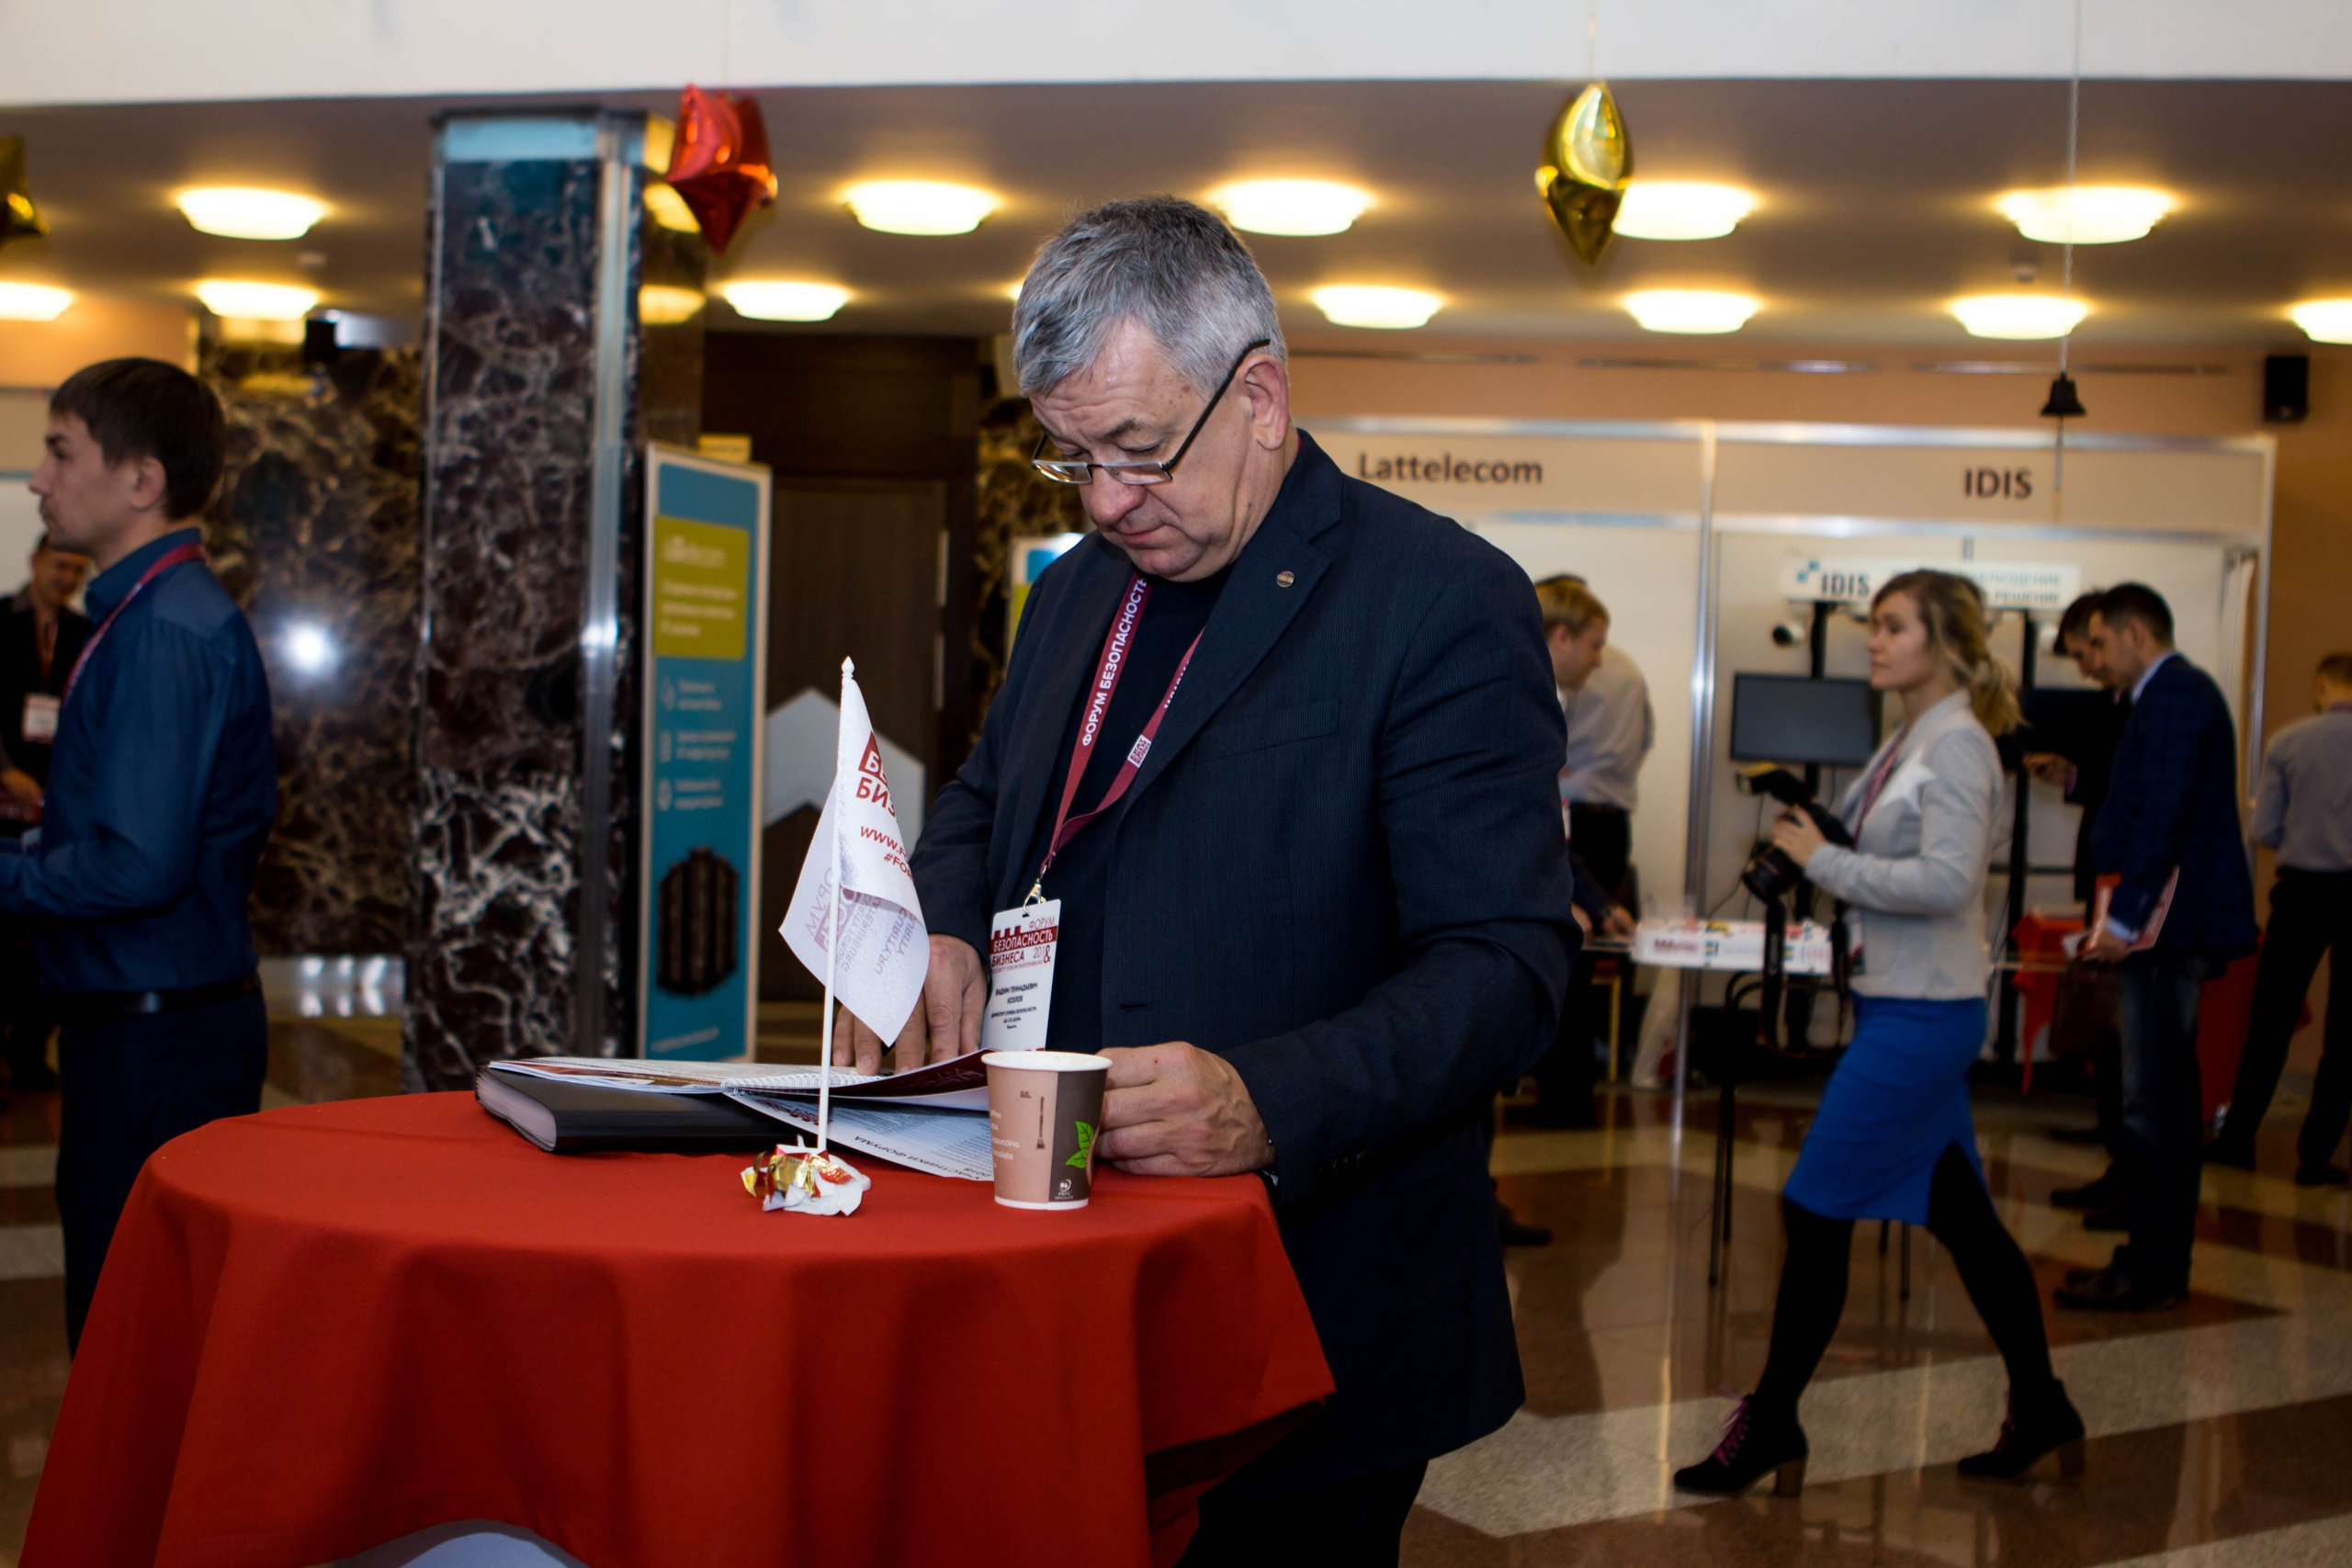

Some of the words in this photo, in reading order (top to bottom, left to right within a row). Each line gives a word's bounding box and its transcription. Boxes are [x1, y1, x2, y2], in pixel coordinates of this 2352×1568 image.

[1359, 452, 1544, 483] Lattelecom
[1965, 467, 2033, 499] IDIS
[1821, 572, 1871, 597] IDIS
[1082, 692, 1108, 747] ФОРУМ
[1100, 578, 1148, 690] БЕЗОПАСНОСТЬ
[1029, 916, 1056, 931] ФОРУМ
[993, 929, 1054, 953] БЕЗОПАСНОСТЬ
[991, 950, 1025, 967] БИЗНЕСА
[854, 1135, 908, 1161] ФОРУМА
[908, 1155, 982, 1181] УЧАСТНИКИ
